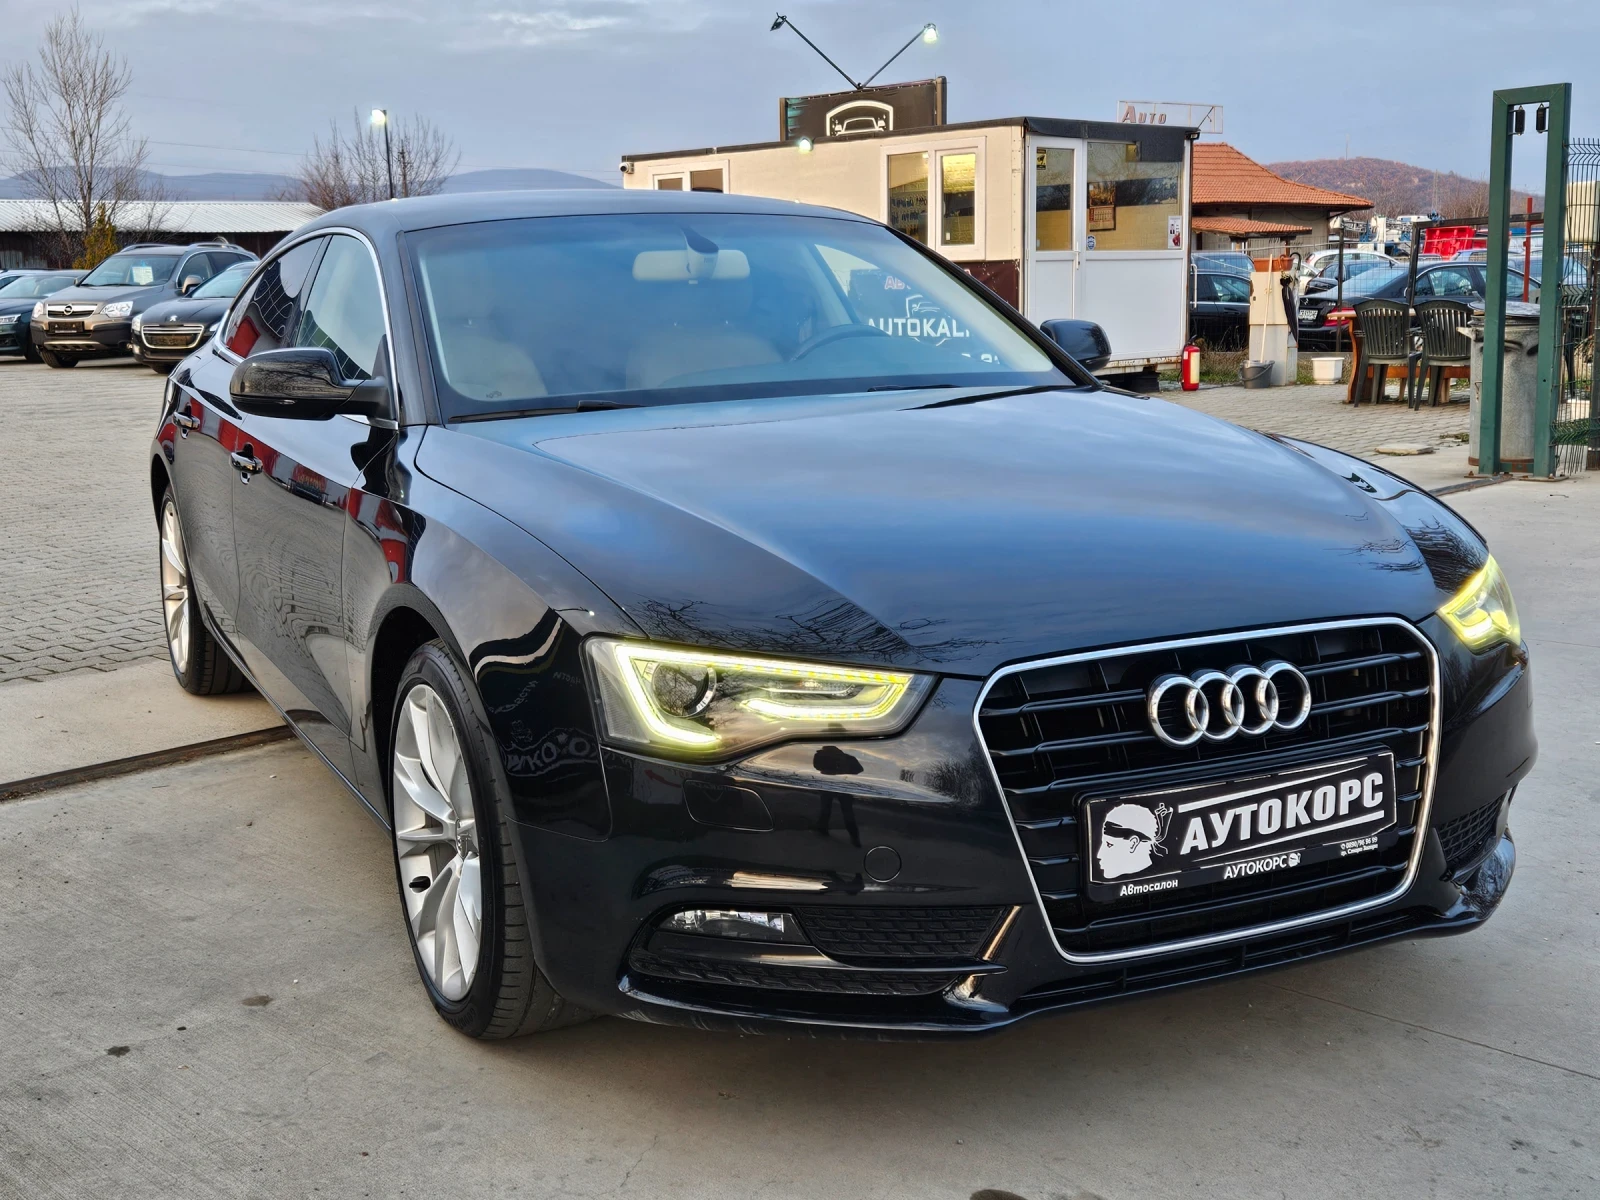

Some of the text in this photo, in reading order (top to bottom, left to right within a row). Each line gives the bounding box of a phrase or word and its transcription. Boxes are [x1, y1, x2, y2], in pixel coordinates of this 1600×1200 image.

[867, 317, 970, 338] UTOKAL
[1180, 772, 1384, 855] АУТОКОРС
[1223, 855, 1287, 880] АУТОКОРС
[1119, 879, 1178, 897] Автосалон
